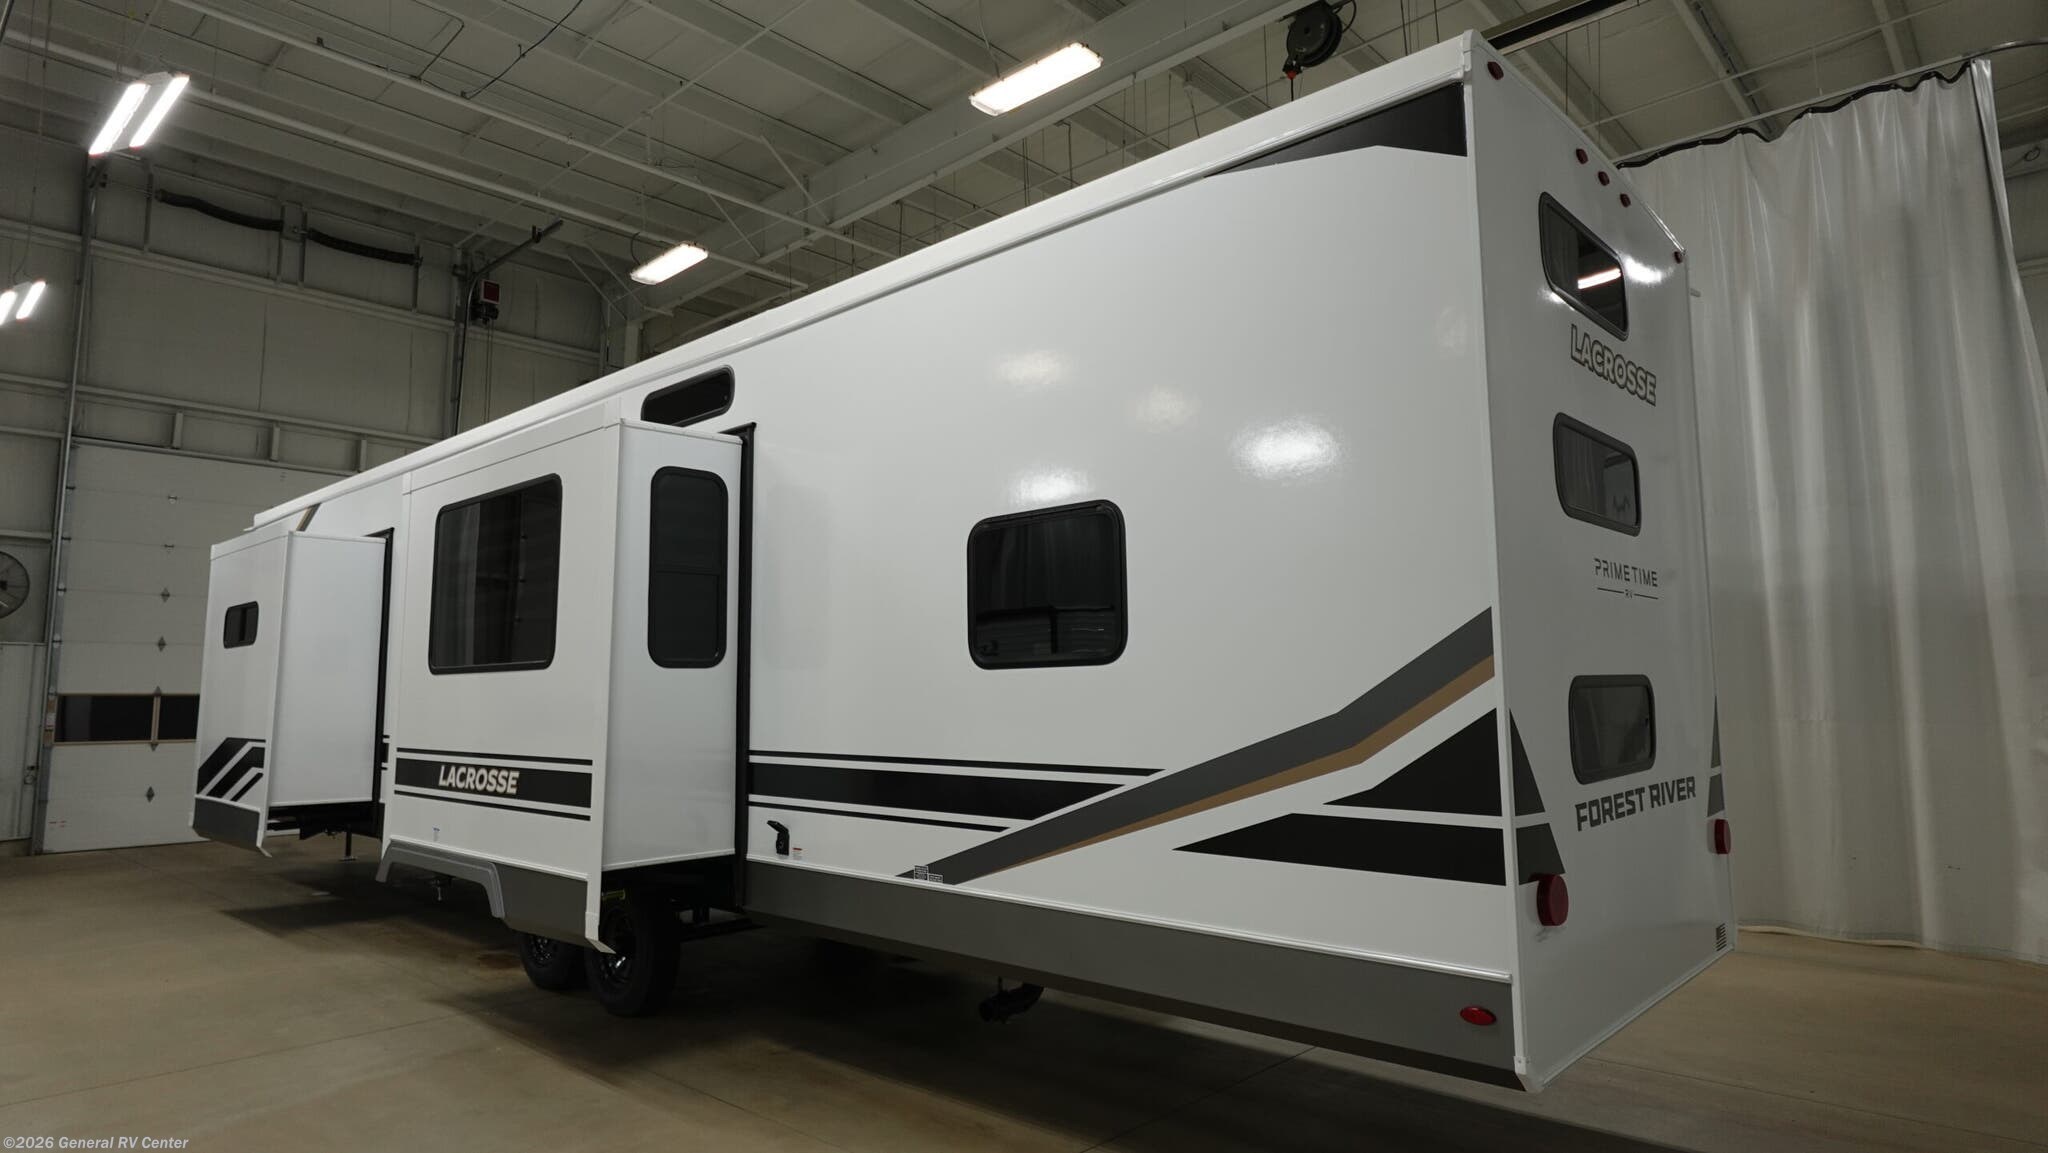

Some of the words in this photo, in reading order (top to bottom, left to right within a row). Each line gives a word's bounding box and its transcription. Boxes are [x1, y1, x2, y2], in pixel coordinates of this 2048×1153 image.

[1570, 323, 1657, 407] LACROSSE
[438, 765, 520, 795] LACROSSE
[1575, 787, 1645, 832] FOREST
[1648, 776, 1696, 808] RIVER
